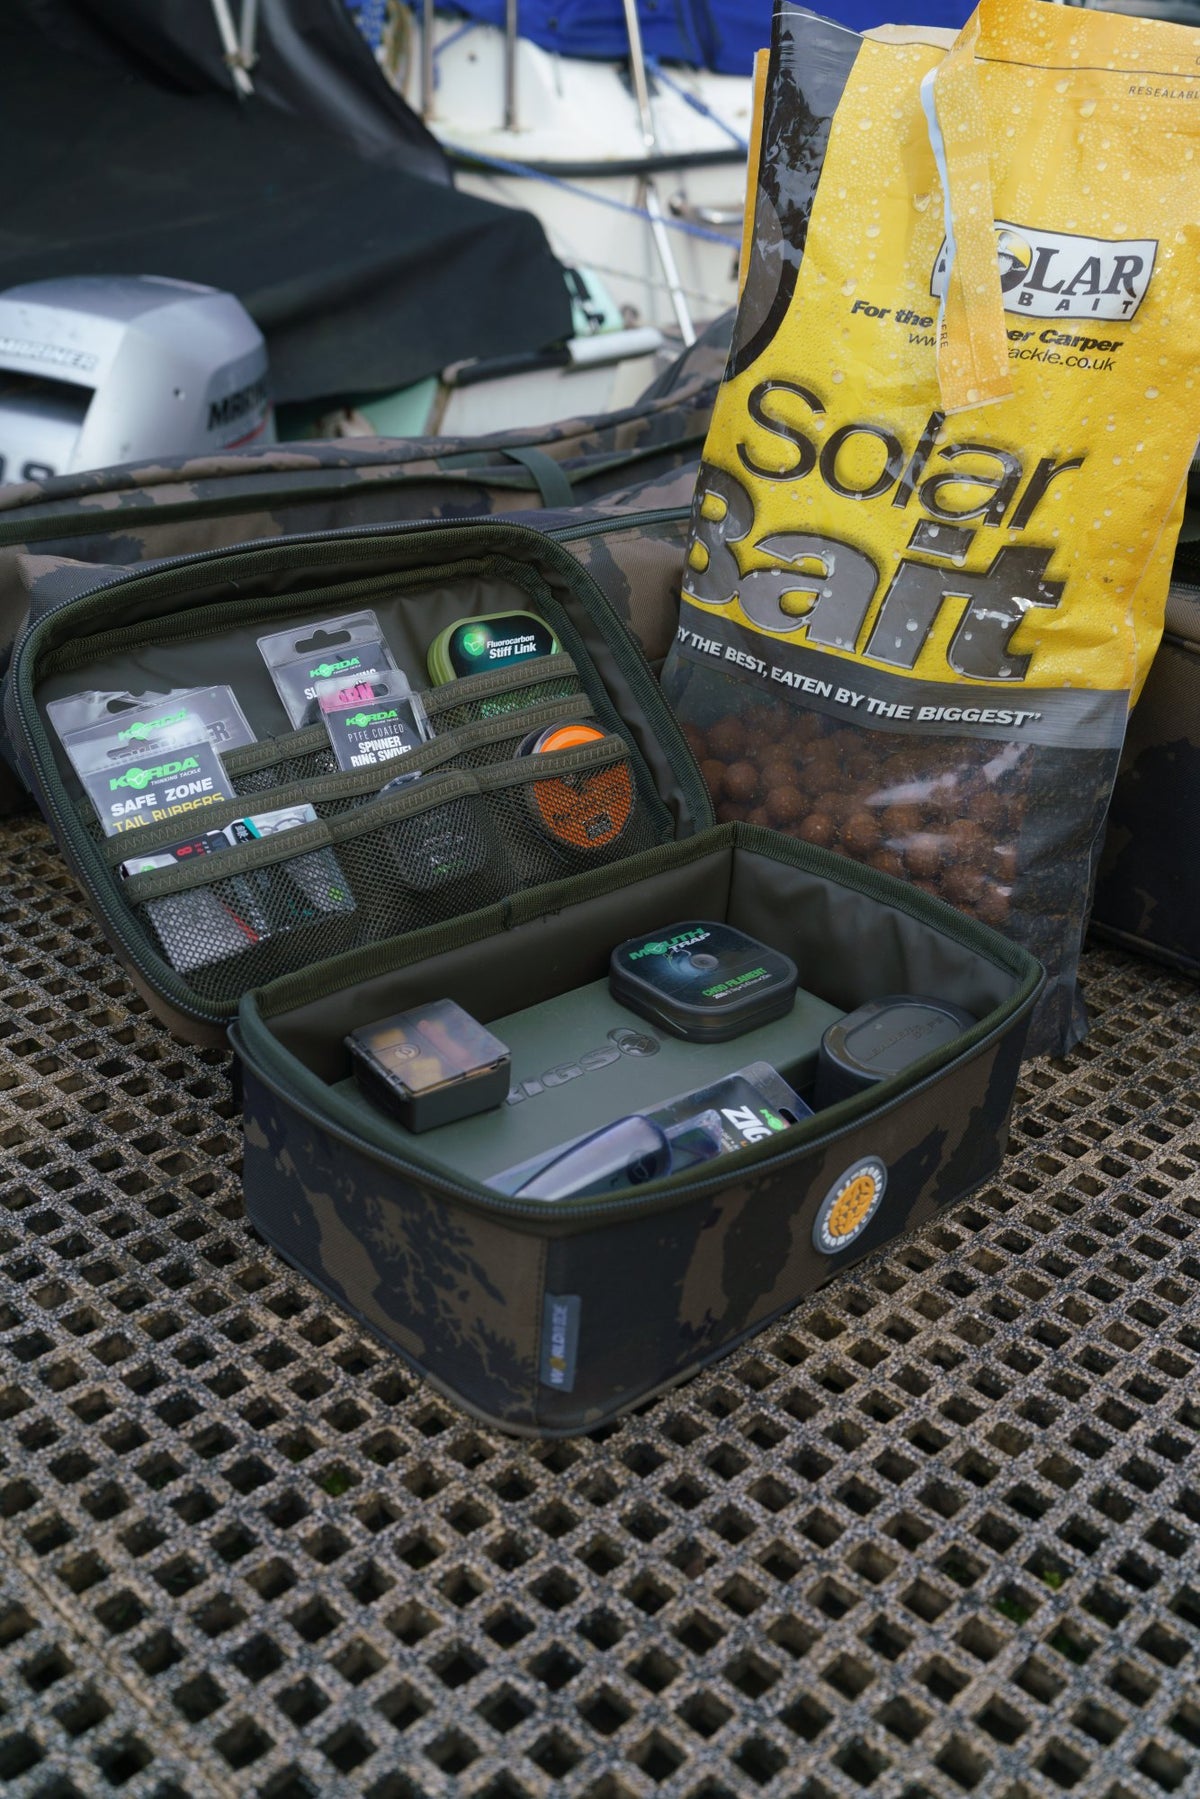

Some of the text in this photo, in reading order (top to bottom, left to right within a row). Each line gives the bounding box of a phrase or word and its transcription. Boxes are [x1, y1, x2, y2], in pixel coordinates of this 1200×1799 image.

[1128, 85, 1200, 100] RESEALABL
[1018, 291, 1133, 315] BAIT
[851, 300, 1124, 353] For the er Carper
[1008, 346, 1117, 372] ackle.co.uk
[736, 379, 1086, 532] Solar
[680, 459, 1066, 684] Bait
[486, 634, 535, 649] Fluorocarbon
[489, 642, 537, 660] Stiff Link
[309, 657, 361, 678] KORDA
[690, 633, 723, 657] THE
[725, 646, 768, 678] BEST,
[771, 666, 833, 698] EATEN
[834, 687, 865, 708] BY
[867, 697, 914, 720] THE
[345, 709, 398, 728] KORDA
[347, 723, 405, 743] PTFE COATED
[358, 735, 403, 754] SPINNER
[350, 752, 378, 768] RING
[109, 756, 199, 791] KORDA
[110, 777, 214, 817] SAFE ZONE
[112, 815, 150, 833] TAIL
[628, 927, 706, 961] MOUTH
[667, 932, 711, 953] TRAP
[724, 967, 768, 988] FILAMENT
